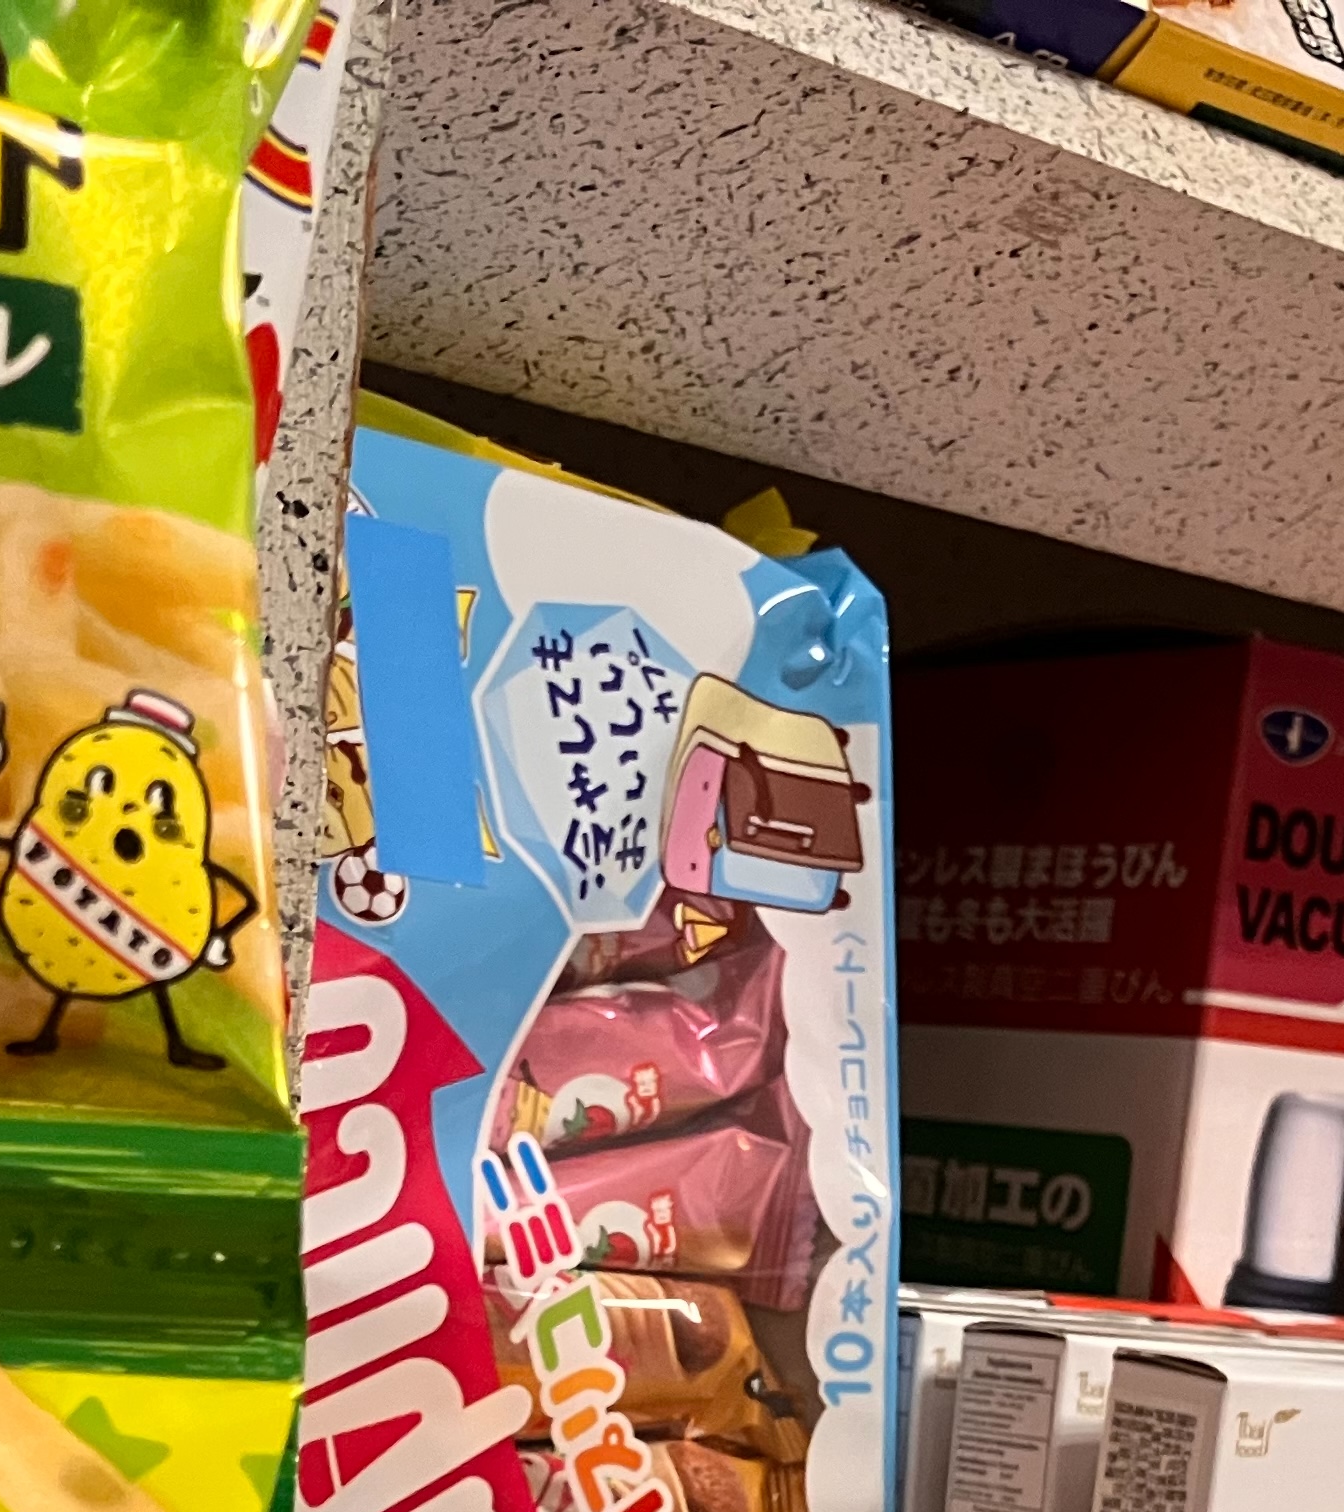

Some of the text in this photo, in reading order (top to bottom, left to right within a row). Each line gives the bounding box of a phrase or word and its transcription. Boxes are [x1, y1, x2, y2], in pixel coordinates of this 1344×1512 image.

[532, 628, 616, 900] 冷やしても
[589, 640, 648, 872] おいしい
[24, 840, 174, 969] POTATO
[894, 839, 1188, 890] ンレス製まほうびん
